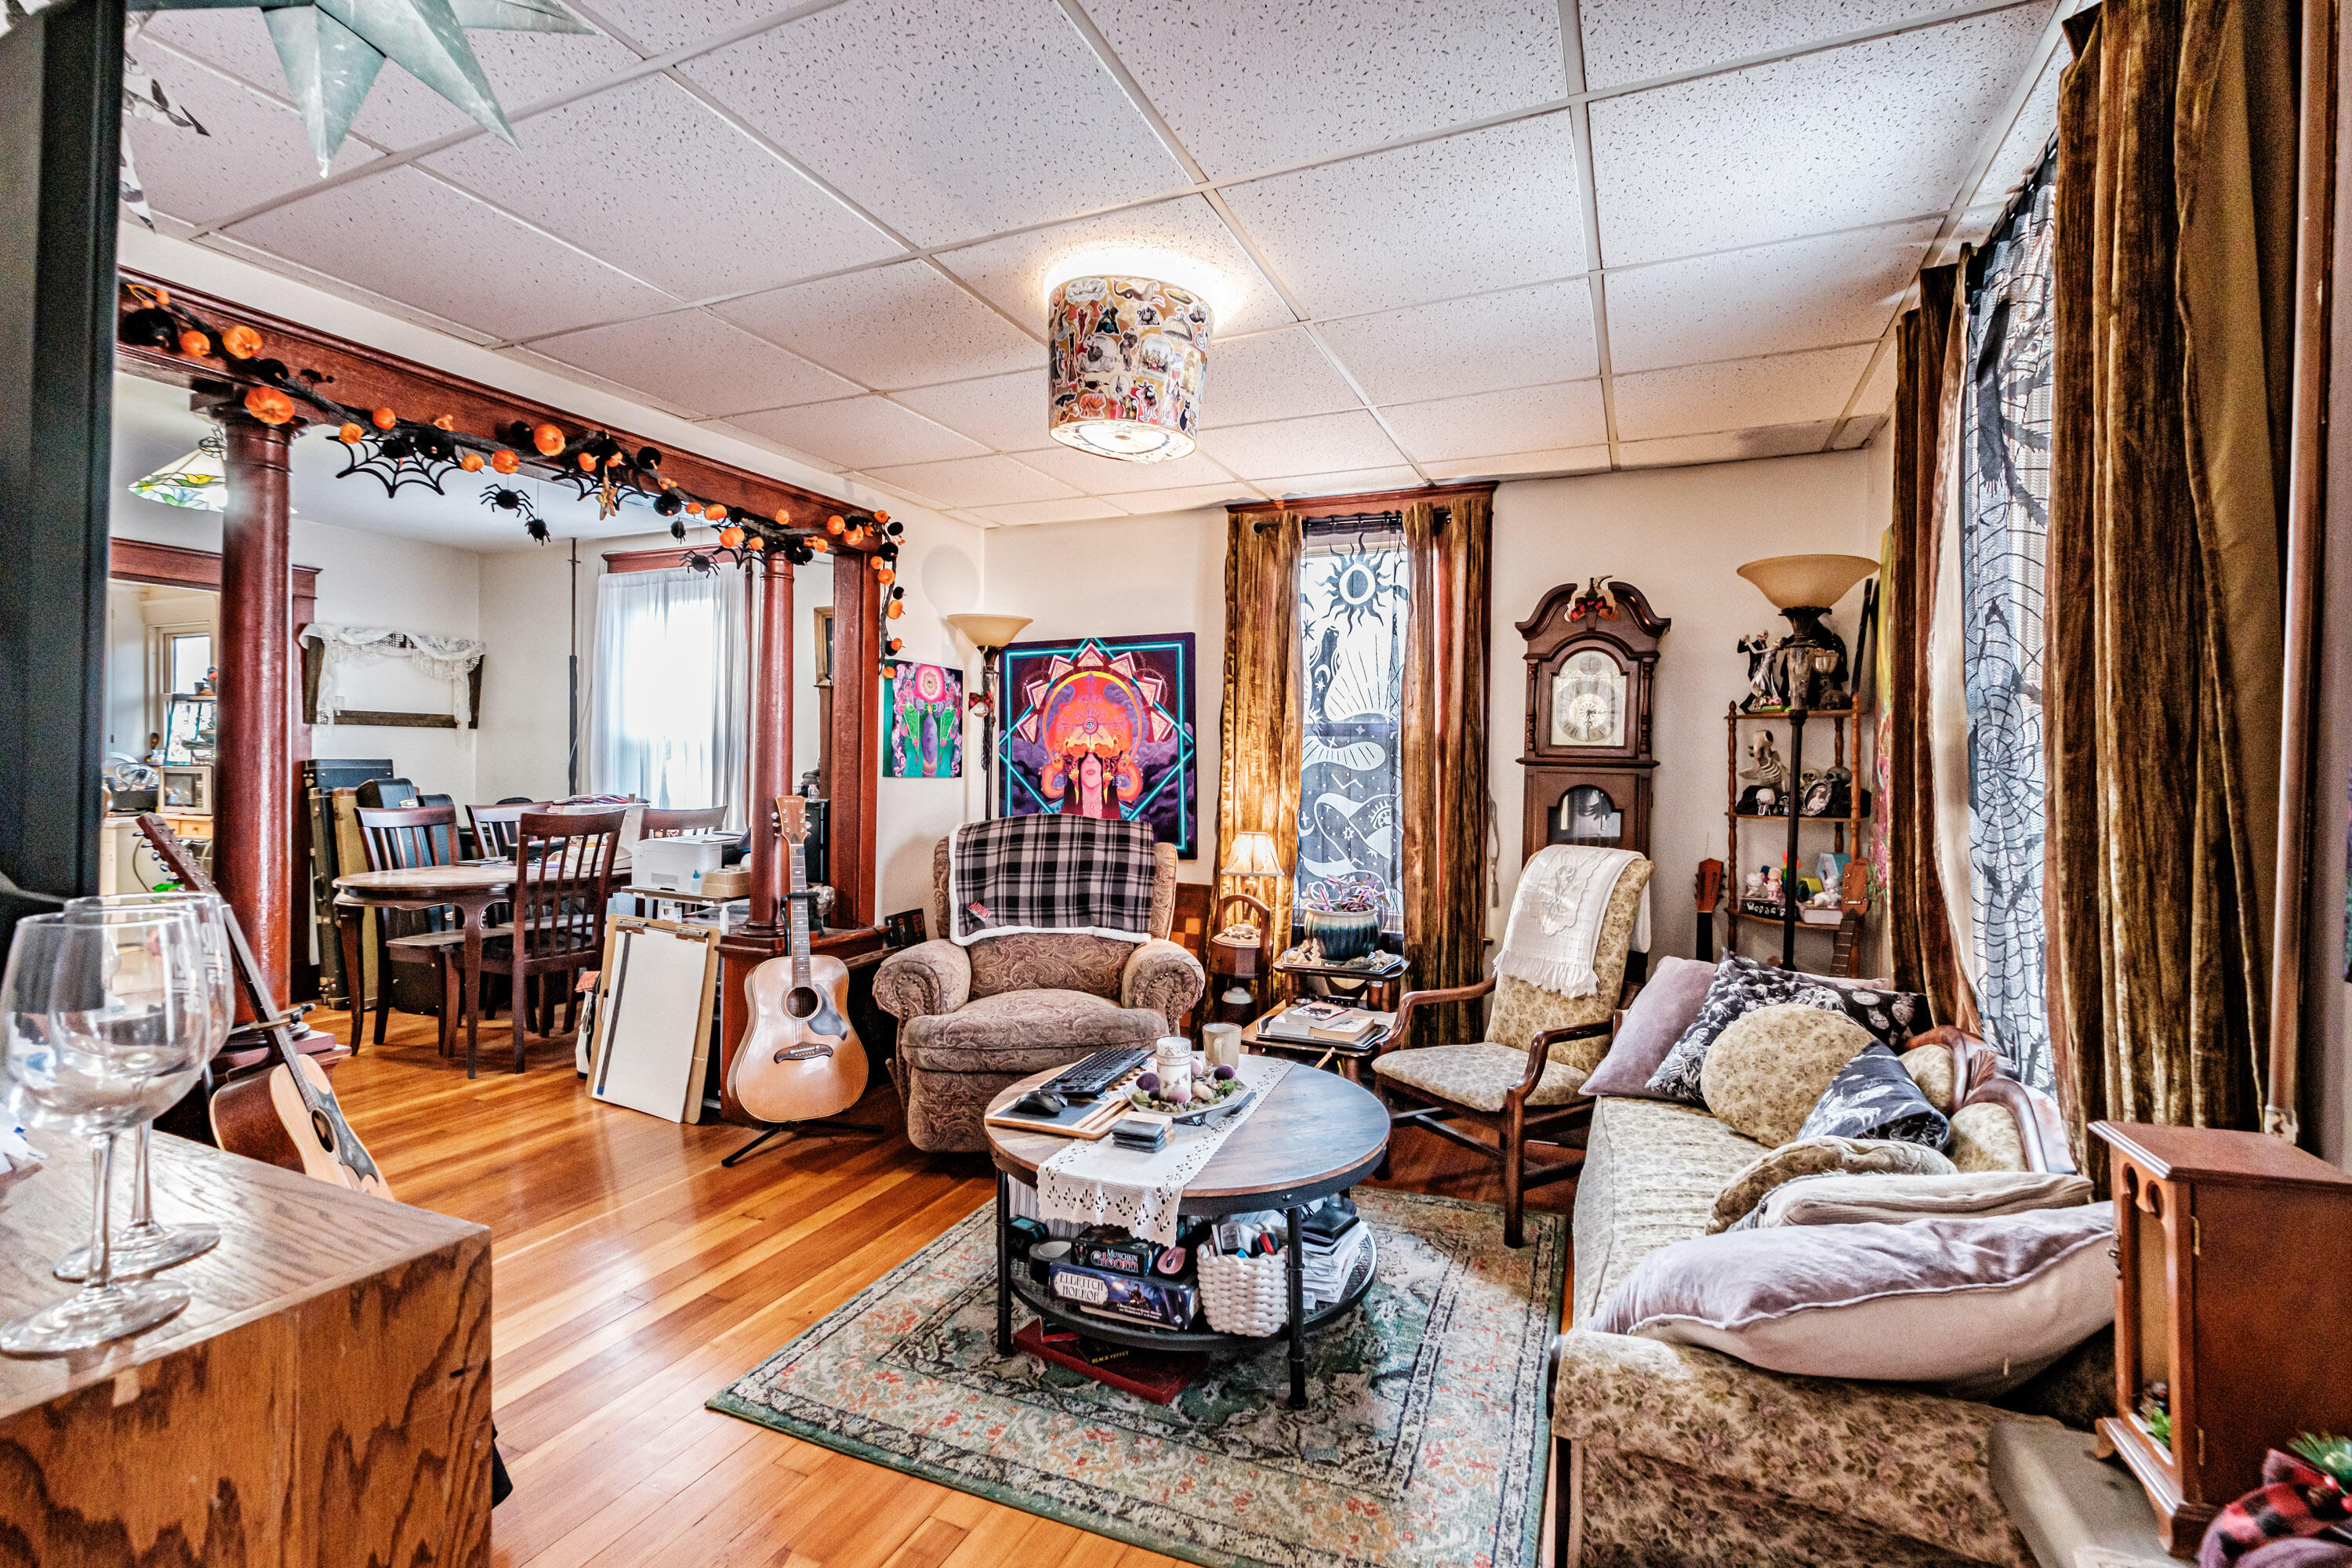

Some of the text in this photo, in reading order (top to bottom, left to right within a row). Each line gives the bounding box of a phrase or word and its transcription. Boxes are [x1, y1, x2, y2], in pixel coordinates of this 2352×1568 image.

[1059, 1273, 1103, 1291] ELDRITCH
[1062, 1285, 1100, 1303] HORROR
[1091, 1350, 1129, 1364] BLACK VELVET
